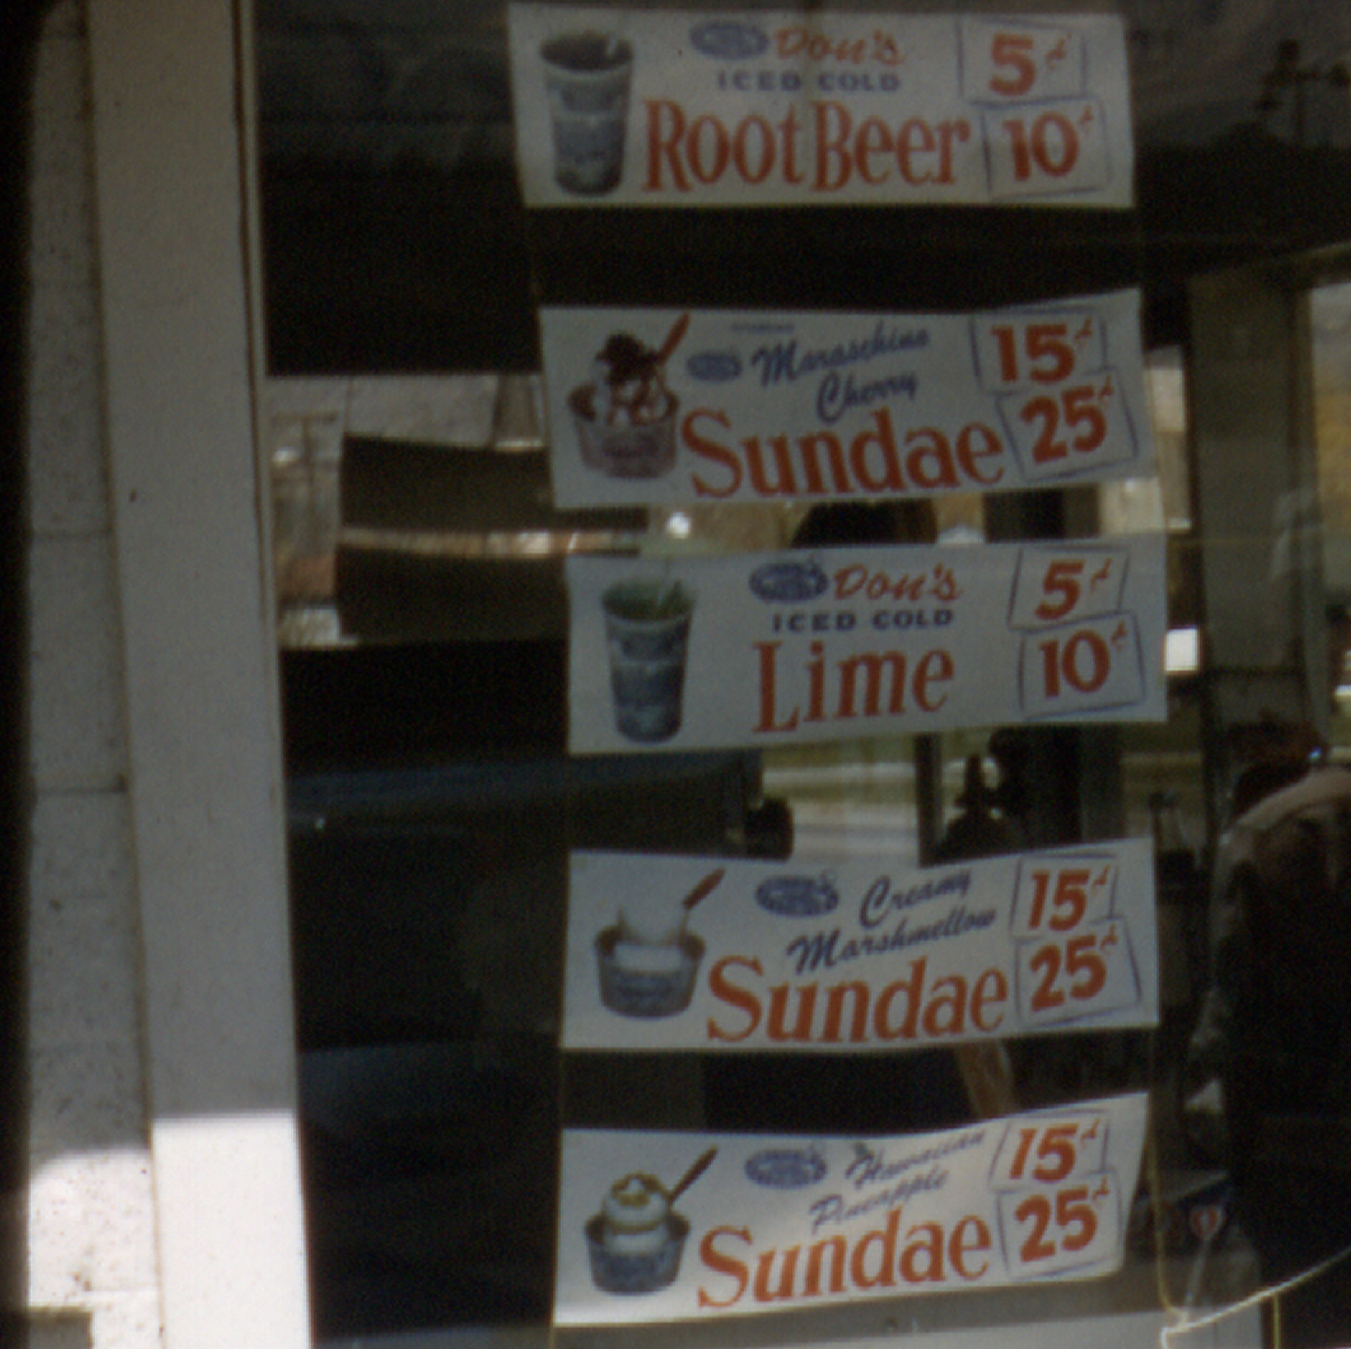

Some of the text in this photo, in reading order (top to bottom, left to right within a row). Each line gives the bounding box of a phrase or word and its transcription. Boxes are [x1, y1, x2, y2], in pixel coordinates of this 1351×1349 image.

[774, 25, 904, 67] Don's
[718, 70, 900, 91] ICED COLD
[642, 98, 971, 192] Root Beer
[751, 318, 929, 388] Maraschino
[815, 369, 918, 425] Cherry
[681, 406, 1005, 499] Sundae
[833, 562, 964, 602] Don's
[772, 608, 954, 632] ICED COLD
[751, 639, 956, 734] Lime
[859, 866, 972, 930] Creamy
[705, 953, 1009, 1045] Sundae
[697, 1208, 993, 1308] Sundae
